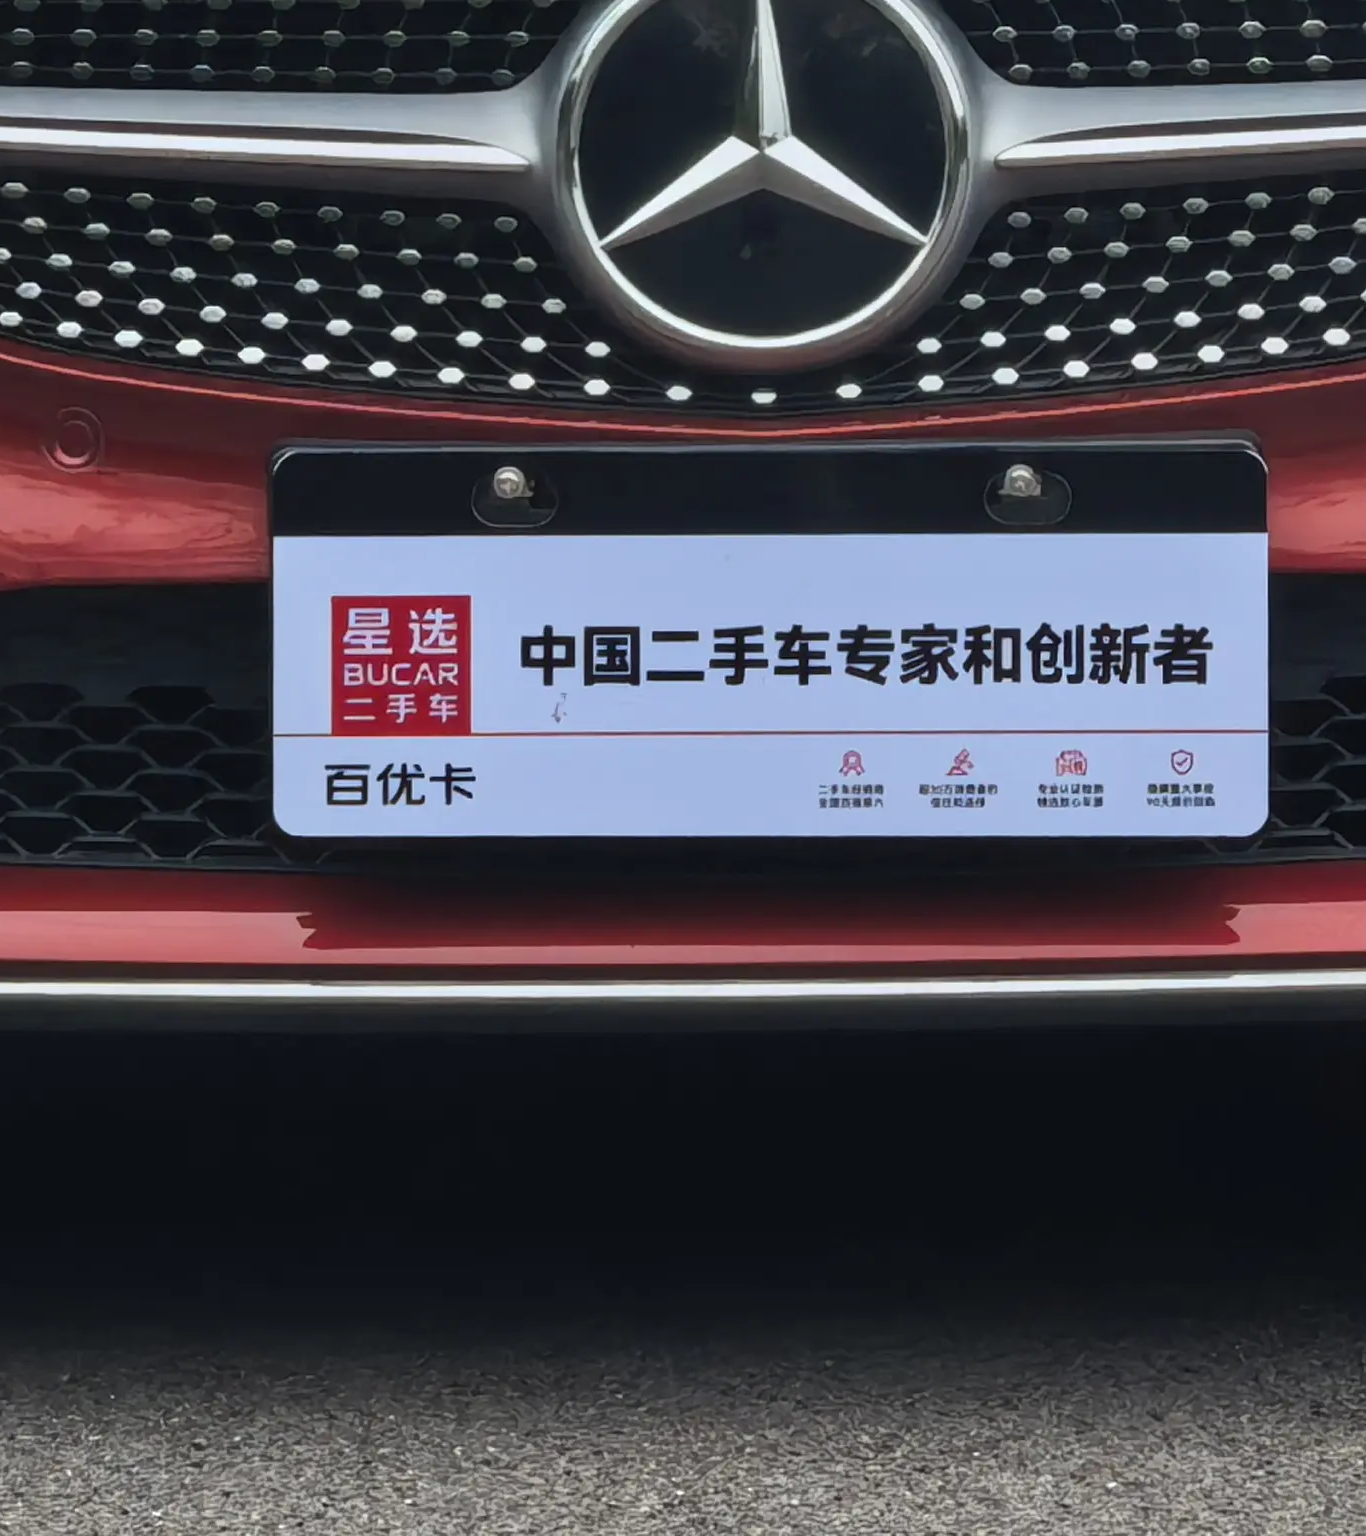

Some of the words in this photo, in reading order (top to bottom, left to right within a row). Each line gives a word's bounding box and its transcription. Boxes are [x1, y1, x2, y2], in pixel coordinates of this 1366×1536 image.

[343, 607, 458, 655] 星选
[343, 662, 459, 687] BUCAR
[520, 622, 1214, 687] 中国二手车专家和创新者
[343, 692, 459, 724] 二手车
[324, 762, 477, 806] 百优卡
